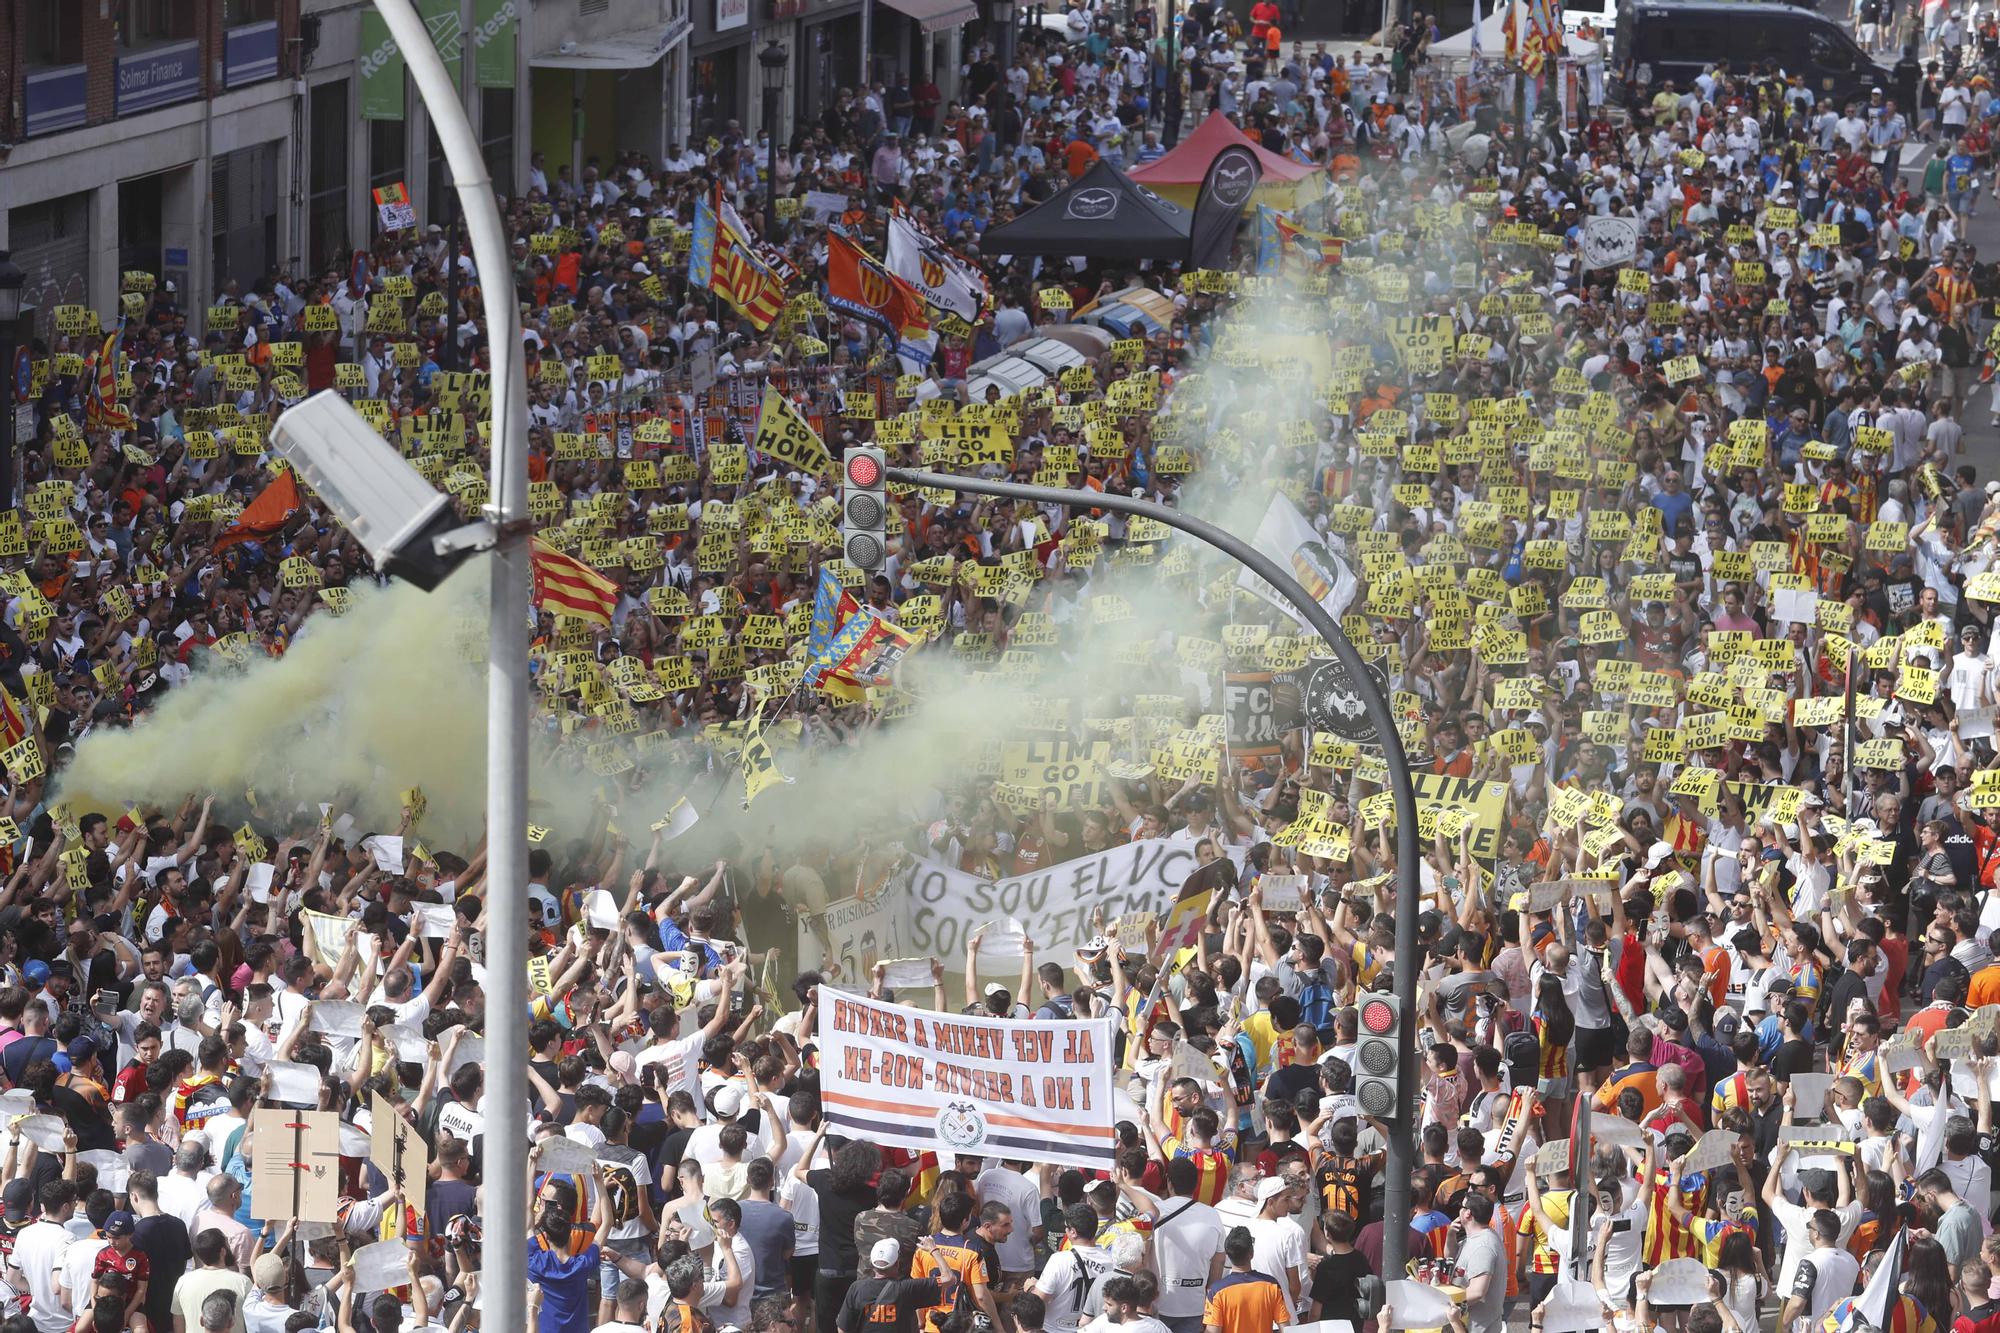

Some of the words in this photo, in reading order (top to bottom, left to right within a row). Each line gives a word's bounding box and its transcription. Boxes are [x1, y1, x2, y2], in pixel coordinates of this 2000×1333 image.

[473, 1, 515, 48] Resa
[360, 33, 397, 79] Res
[120, 68, 150, 90] Solmar
[151, 61, 183, 82] Finance
[1740, 262, 1761, 272] LIM
[1736, 274, 1765, 284] HOME
[311, 307, 329, 315] LIM
[306, 321, 336, 329] HOME
[1395, 316, 1440, 334] LIM
[1406, 335, 1429, 346] GO
[448, 373, 491, 392] LIM
[413, 414, 452, 433] LIM
[784, 423, 810, 442] GO
[942, 425, 991, 438] LIM
[1098, 431, 1118, 440] LIM
[428, 434, 448, 442] LIM
[61, 441, 80, 451] LIM
[756, 430, 830, 472] HOME
[958, 440, 983, 451] GO
[422, 449, 453, 458] HOME
[1092, 447, 1124, 456] HOME
[56, 456, 89, 465] HOME
[958, 450, 1012, 465] OME
[631, 463, 649, 472] LIM
[627, 478, 659, 488] HOME
[1815, 516, 1838, 525] LIM
[1875, 524, 1899, 533] LIM
[1808, 532, 1845, 541] HOME
[1533, 542, 1558, 551] LIM
[1868, 541, 1904, 549] HOME
[1527, 559, 1564, 568] HOME
[1721, 554, 1746, 563] LIM
[1712, 570, 1751, 581] HOME
[1377, 585, 1403, 596] LIM
[906, 596, 931, 607] LIM
[1438, 592, 1459, 601] LIM
[1368, 605, 1408, 616] HOME
[1435, 609, 1469, 618] HOME
[751, 616, 777, 627] LIM
[900, 615, 940, 626] HOME
[1587, 613, 1612, 624] LIM
[1583, 630, 1622, 642] HOME
[741, 637, 783, 647] HOME
[561, 653, 595, 665] HOME
[661, 658, 684, 669] LIM
[572, 673, 594, 684] LIM
[1910, 667, 1929, 681] LIM
[662, 676, 694, 690] HOME
[1700, 673, 1729, 687] LIM
[1705, 685, 1718, 694] GO
[1900, 687, 1933, 701] HOME
[1688, 692, 1732, 709] HOME
[1732, 707, 1757, 719] LIM
[1689, 713, 1715, 728] LIM
[1737, 718, 1750, 727] GO
[1352, 727, 1377, 738] HOM
[1650, 730, 1675, 741] LIM
[1697, 727, 1711, 735] GO
[1322, 734, 1348, 745] LIM
[1686, 733, 1726, 748] HOME
[1863, 741, 1892, 750] LIM
[1027, 741, 1093, 763] LIM
[1181, 746, 1210, 759] LIM
[1644, 750, 1684, 761] HOME
[1187, 759, 1201, 767] GO
[1312, 754, 1354, 766] HOME
[1854, 757, 1900, 768] HOME
[1043, 765, 1079, 783] GO
[1414, 775, 1485, 803] LIM
[1672, 782, 1709, 794] HOME
[996, 791, 1038, 808] HOME
[1565, 790, 1585, 805] LIM
[1781, 790, 1799, 801] LIM
[1550, 807, 1577, 825] HOME
[1314, 822, 1343, 836] LIM
[1320, 836, 1334, 844] GO
[1945, 834, 1974, 843] dida
[1301, 842, 1347, 858] HOME
[966, 874, 1052, 916] SOU
[1071, 856, 1118, 901] EL
[188, 1107, 221, 1119] VALENCIA
[443, 1114, 473, 1134] AIMAR
